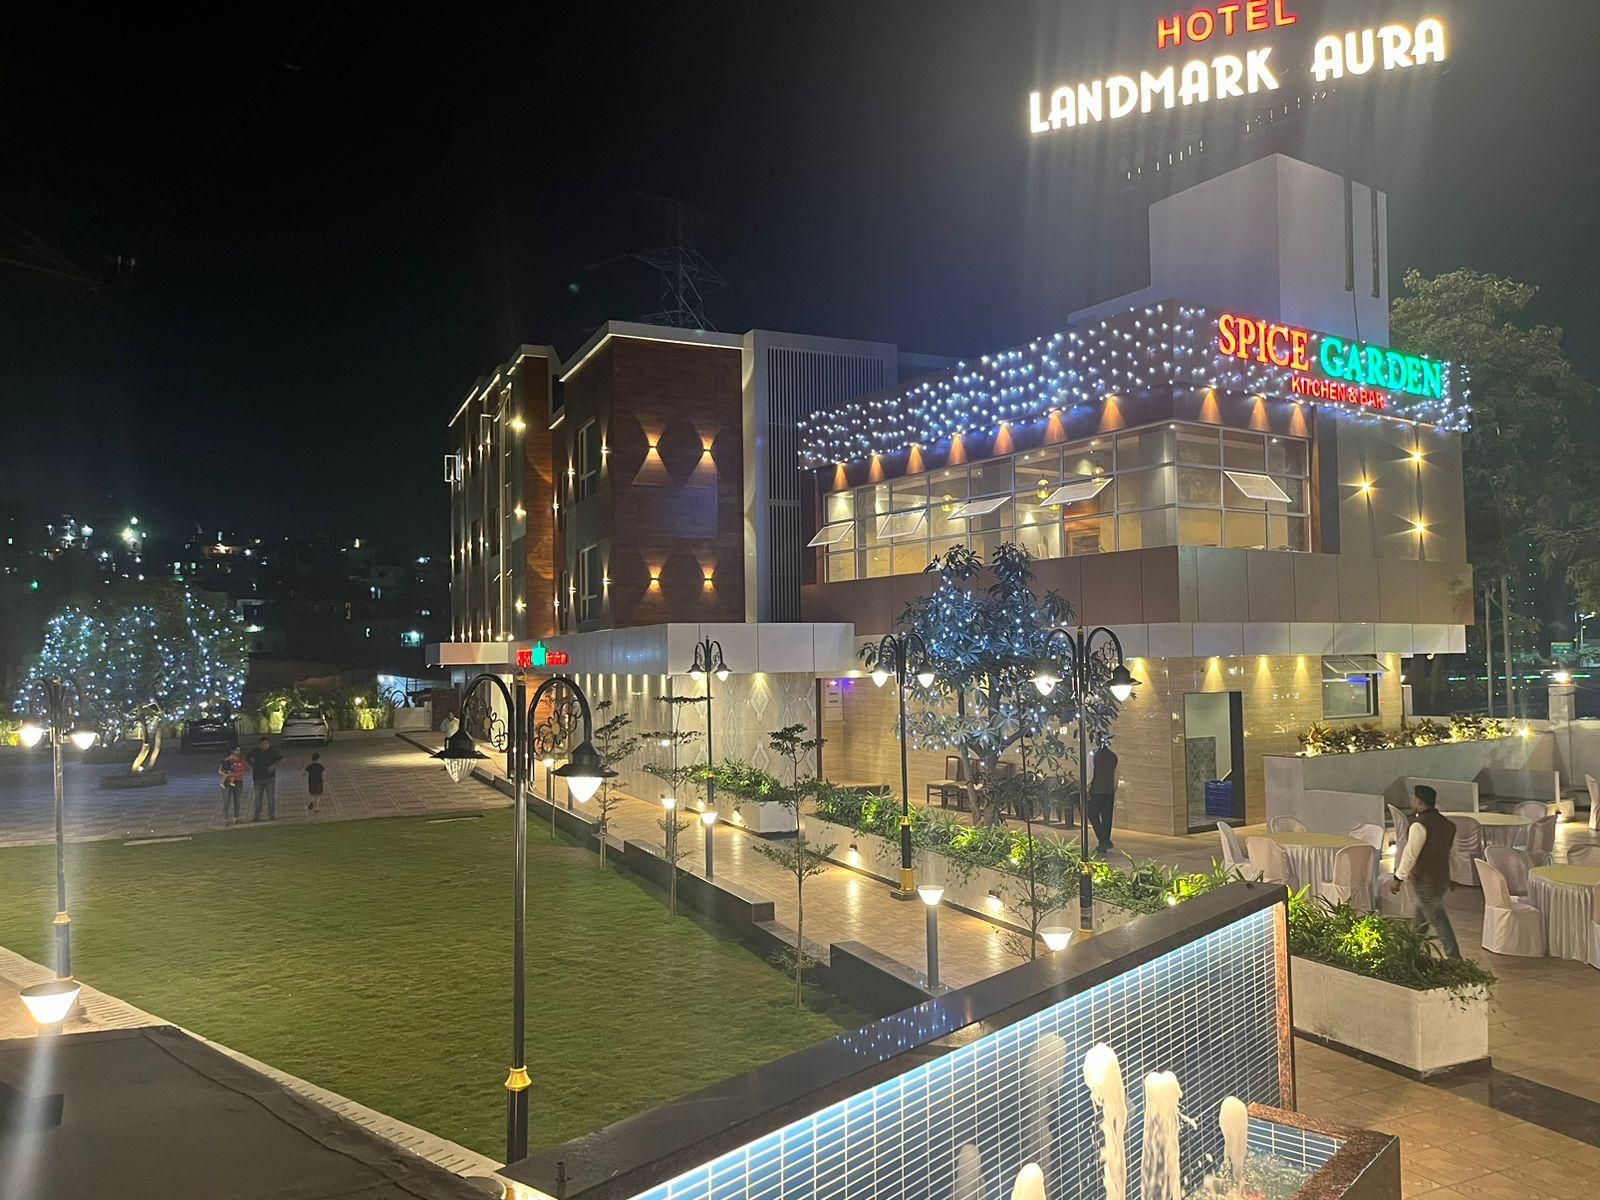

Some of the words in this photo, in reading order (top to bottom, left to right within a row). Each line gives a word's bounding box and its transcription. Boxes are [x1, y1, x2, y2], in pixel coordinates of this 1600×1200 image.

[1157, 0, 1297, 49] HOTEL
[1029, 47, 1279, 134] LANDMARK
[1310, 19, 1446, 82] AURA
[1218, 313, 1310, 371] SPICE
[1320, 336, 1442, 399] GARDEN
[1291, 376, 1346, 401] KITCHEN
[1348, 387, 1358, 404] &
[1360, 391, 1385, 409] BAR
